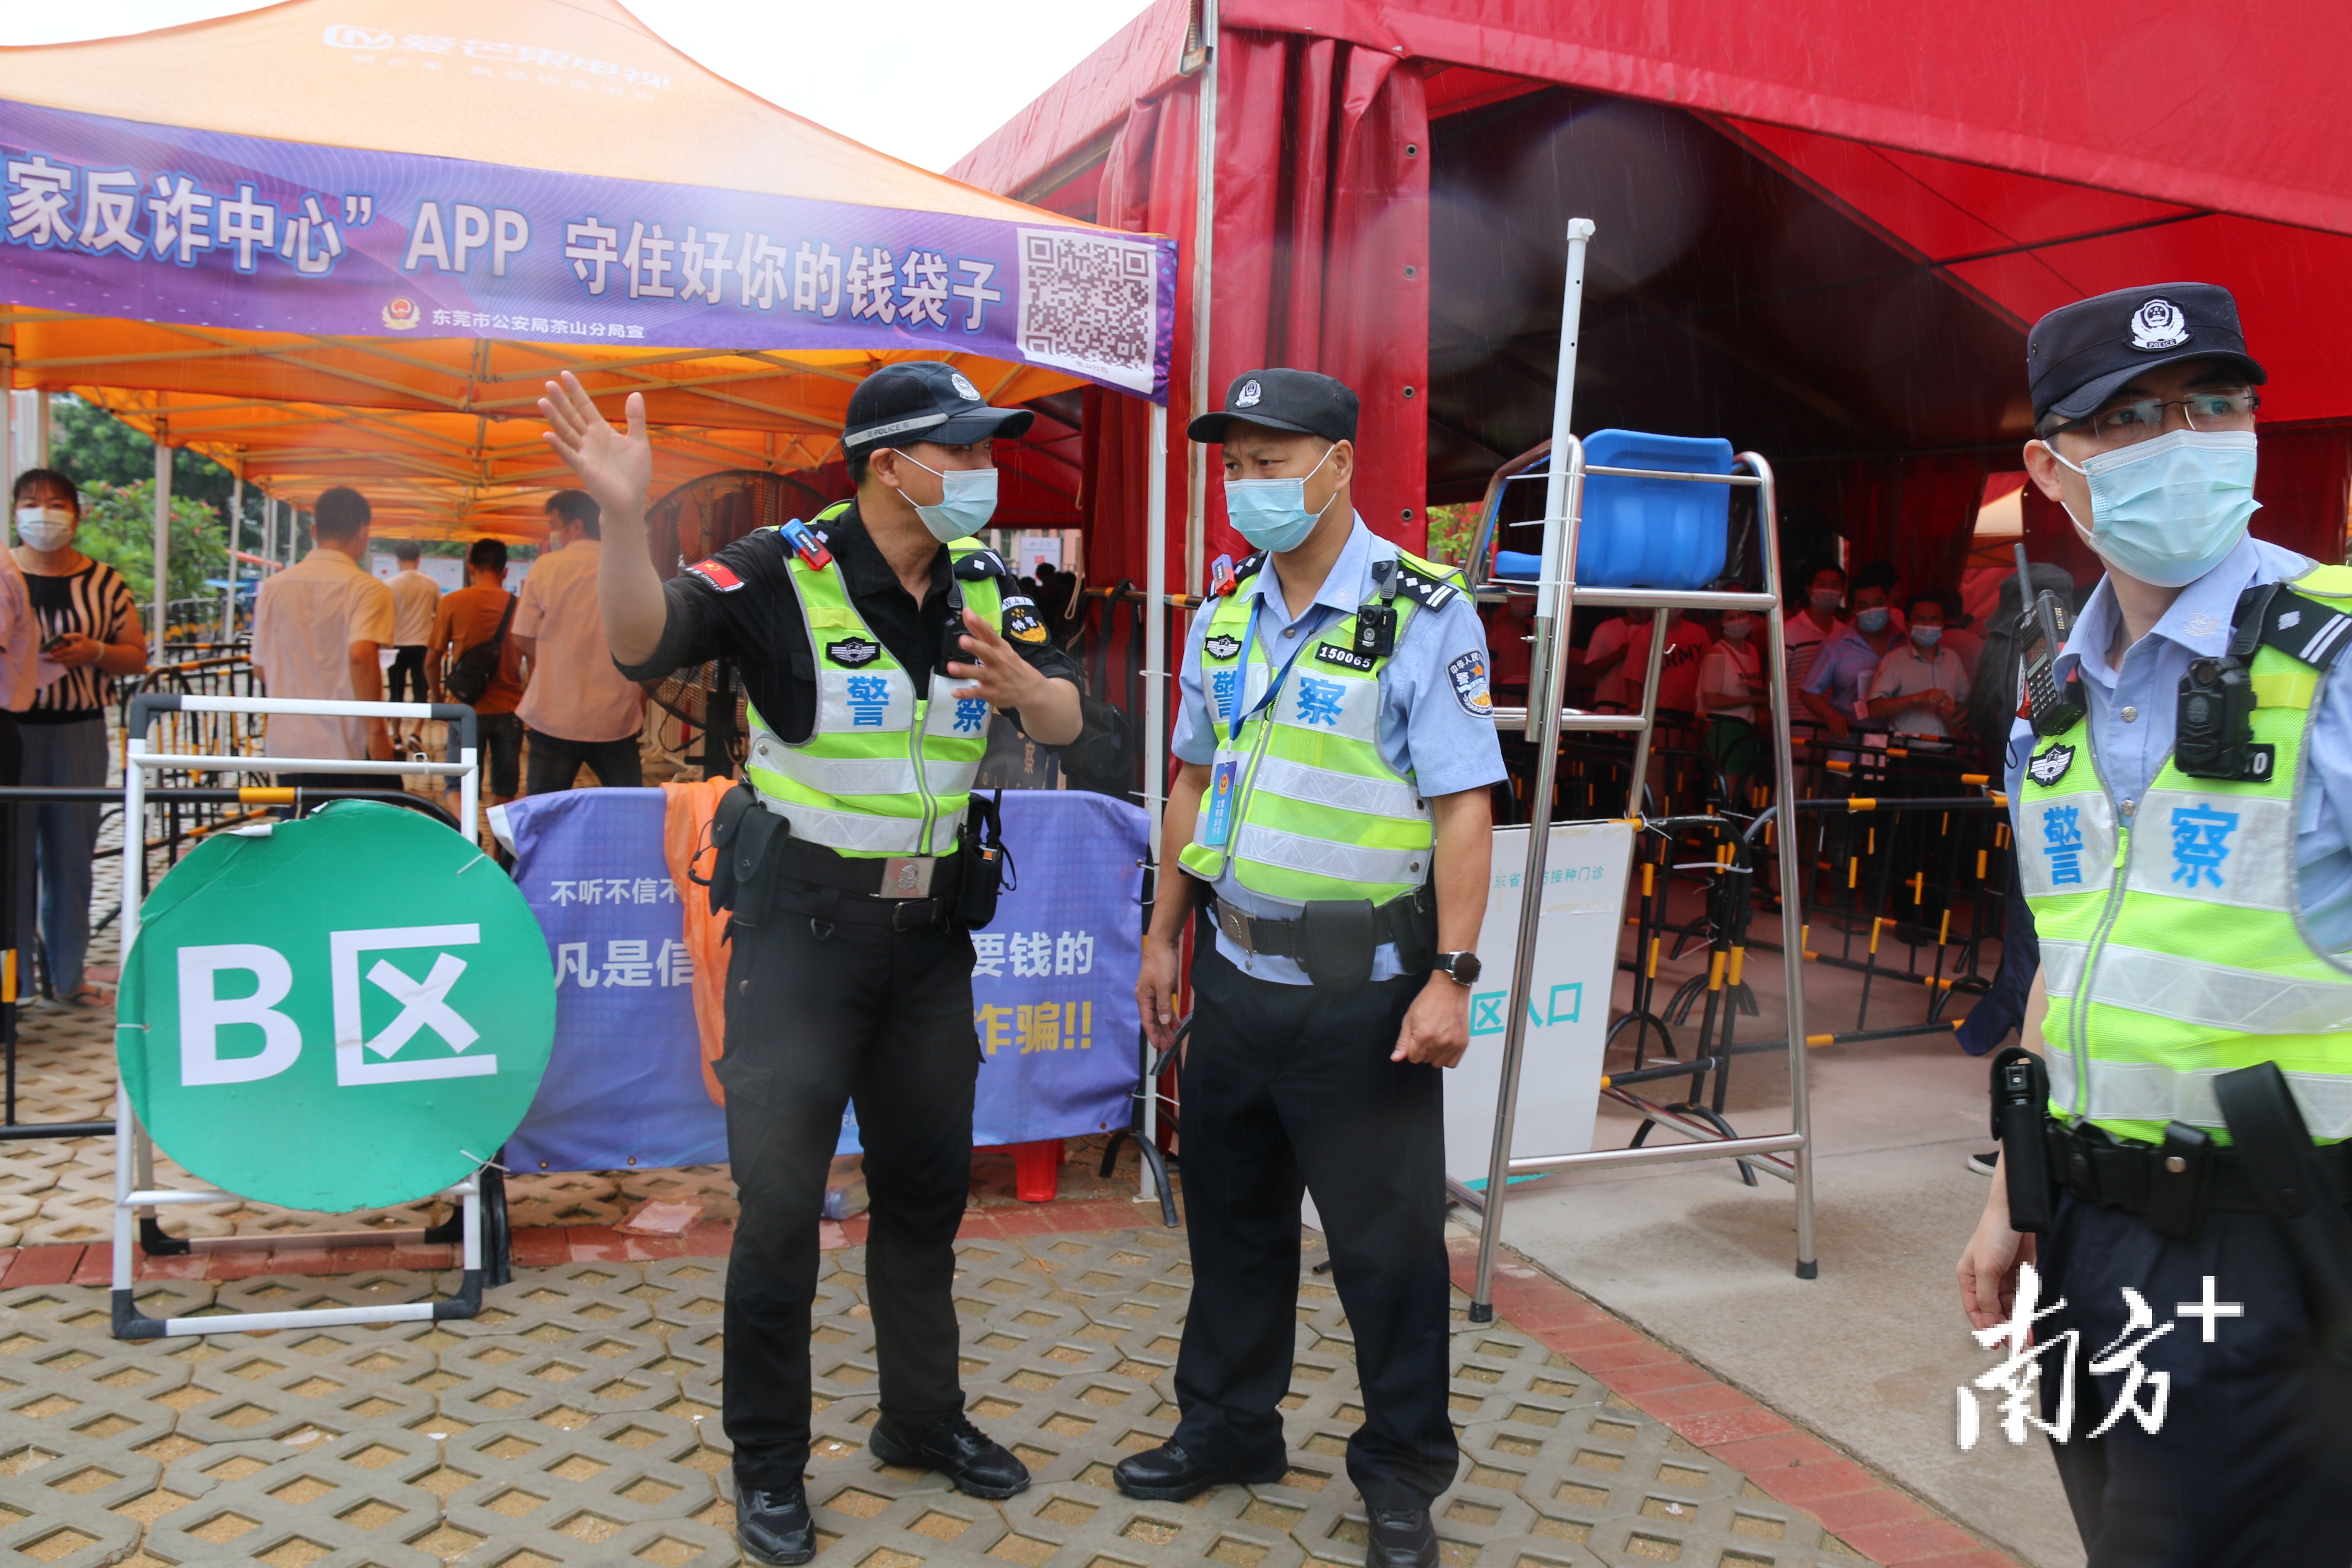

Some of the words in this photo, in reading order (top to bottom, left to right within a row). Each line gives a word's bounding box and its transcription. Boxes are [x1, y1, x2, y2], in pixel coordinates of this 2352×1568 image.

[7, 156, 372, 273] 家反诈中心”
[405, 201, 530, 277] APP
[565, 216, 1002, 331] 守住好你的钱袋子
[432, 309, 645, 339] 东莞市公安局茶山分局宣
[2149, 340, 2175, 348] POLICE
[873, 423, 901, 436] POLICE
[1319, 646, 1372, 668] 150065
[1662, 643, 1703, 670] RMY
[846, 676, 890, 726] 警
[1296, 678, 1347, 726] 察
[2043, 805, 2084, 885] 警
[2170, 802, 2240, 888] 察
[550, 877, 679, 907] 不听不信不
[554, 938, 695, 989] 凡是信
[970, 930, 1094, 978] 要钱的
[176, 922, 499, 1087] B区
